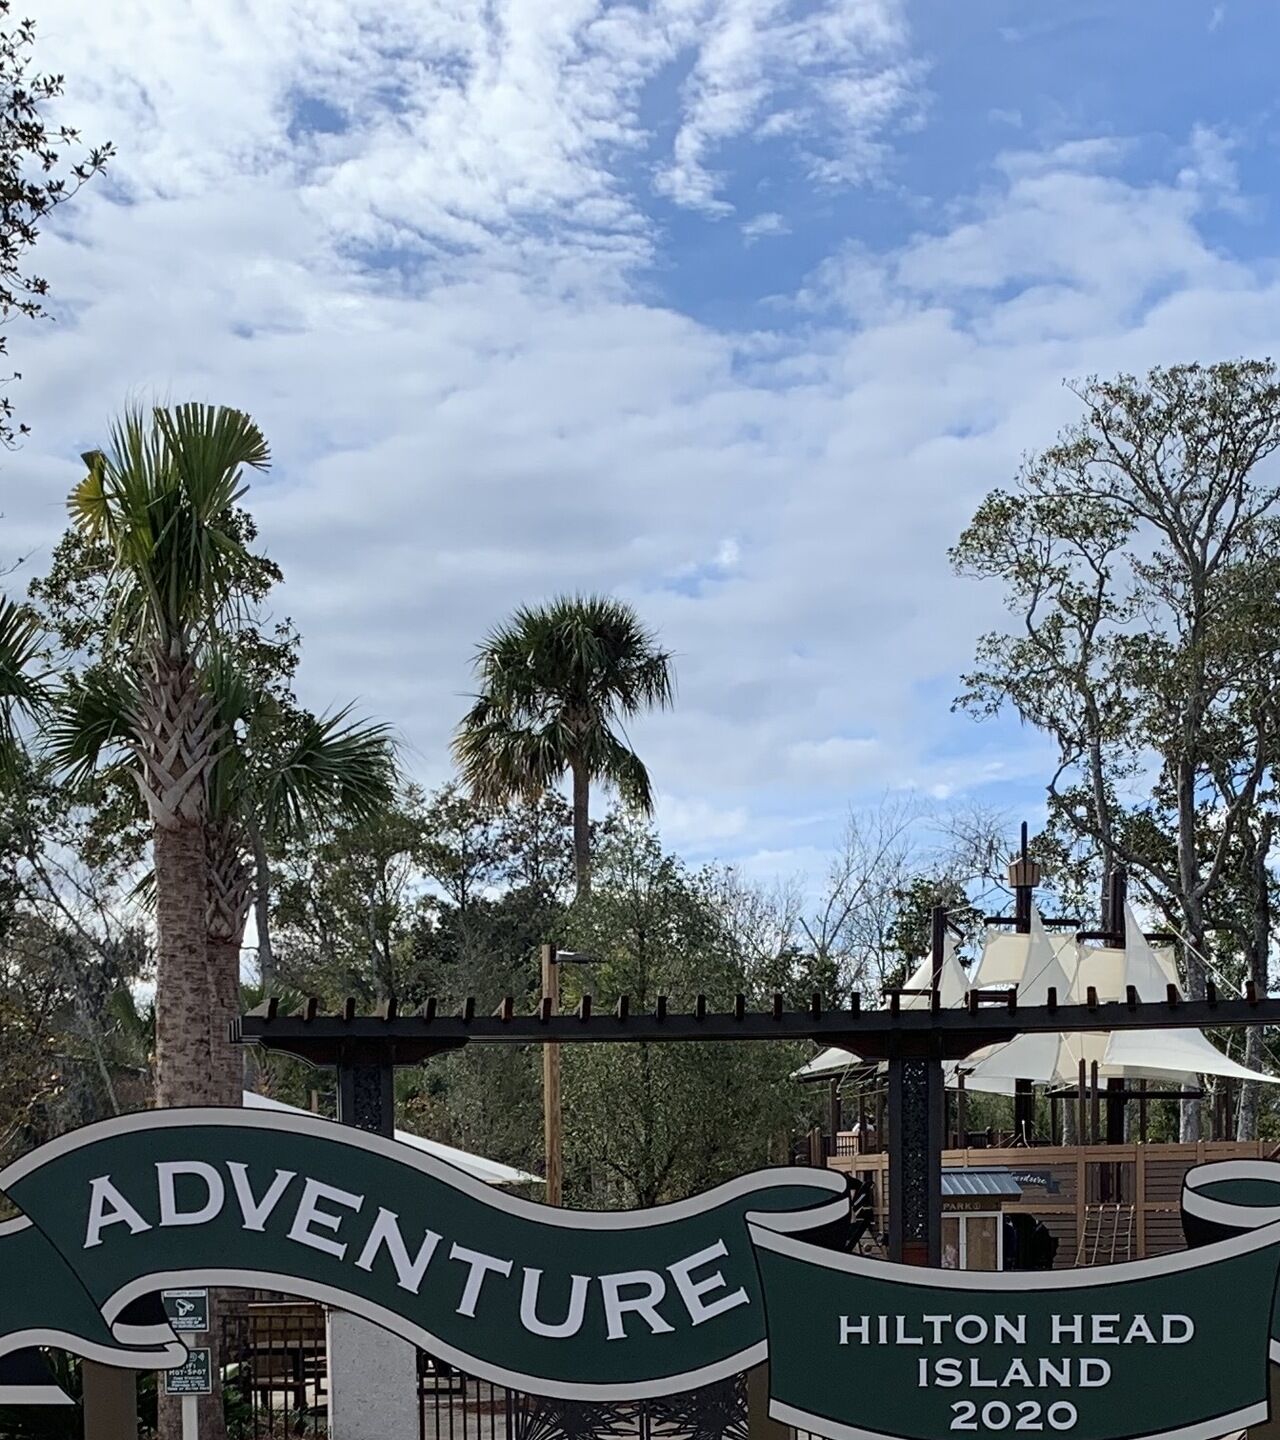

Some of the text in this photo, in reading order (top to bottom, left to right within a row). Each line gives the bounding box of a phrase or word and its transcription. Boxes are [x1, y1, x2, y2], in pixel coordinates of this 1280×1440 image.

[83, 1160, 750, 1340] ADVENTURE
[839, 1313, 1195, 1345] HILTON HEAD
[918, 1357, 1111, 1388] ISLAND
[950, 1400, 1078, 1431] 2020
